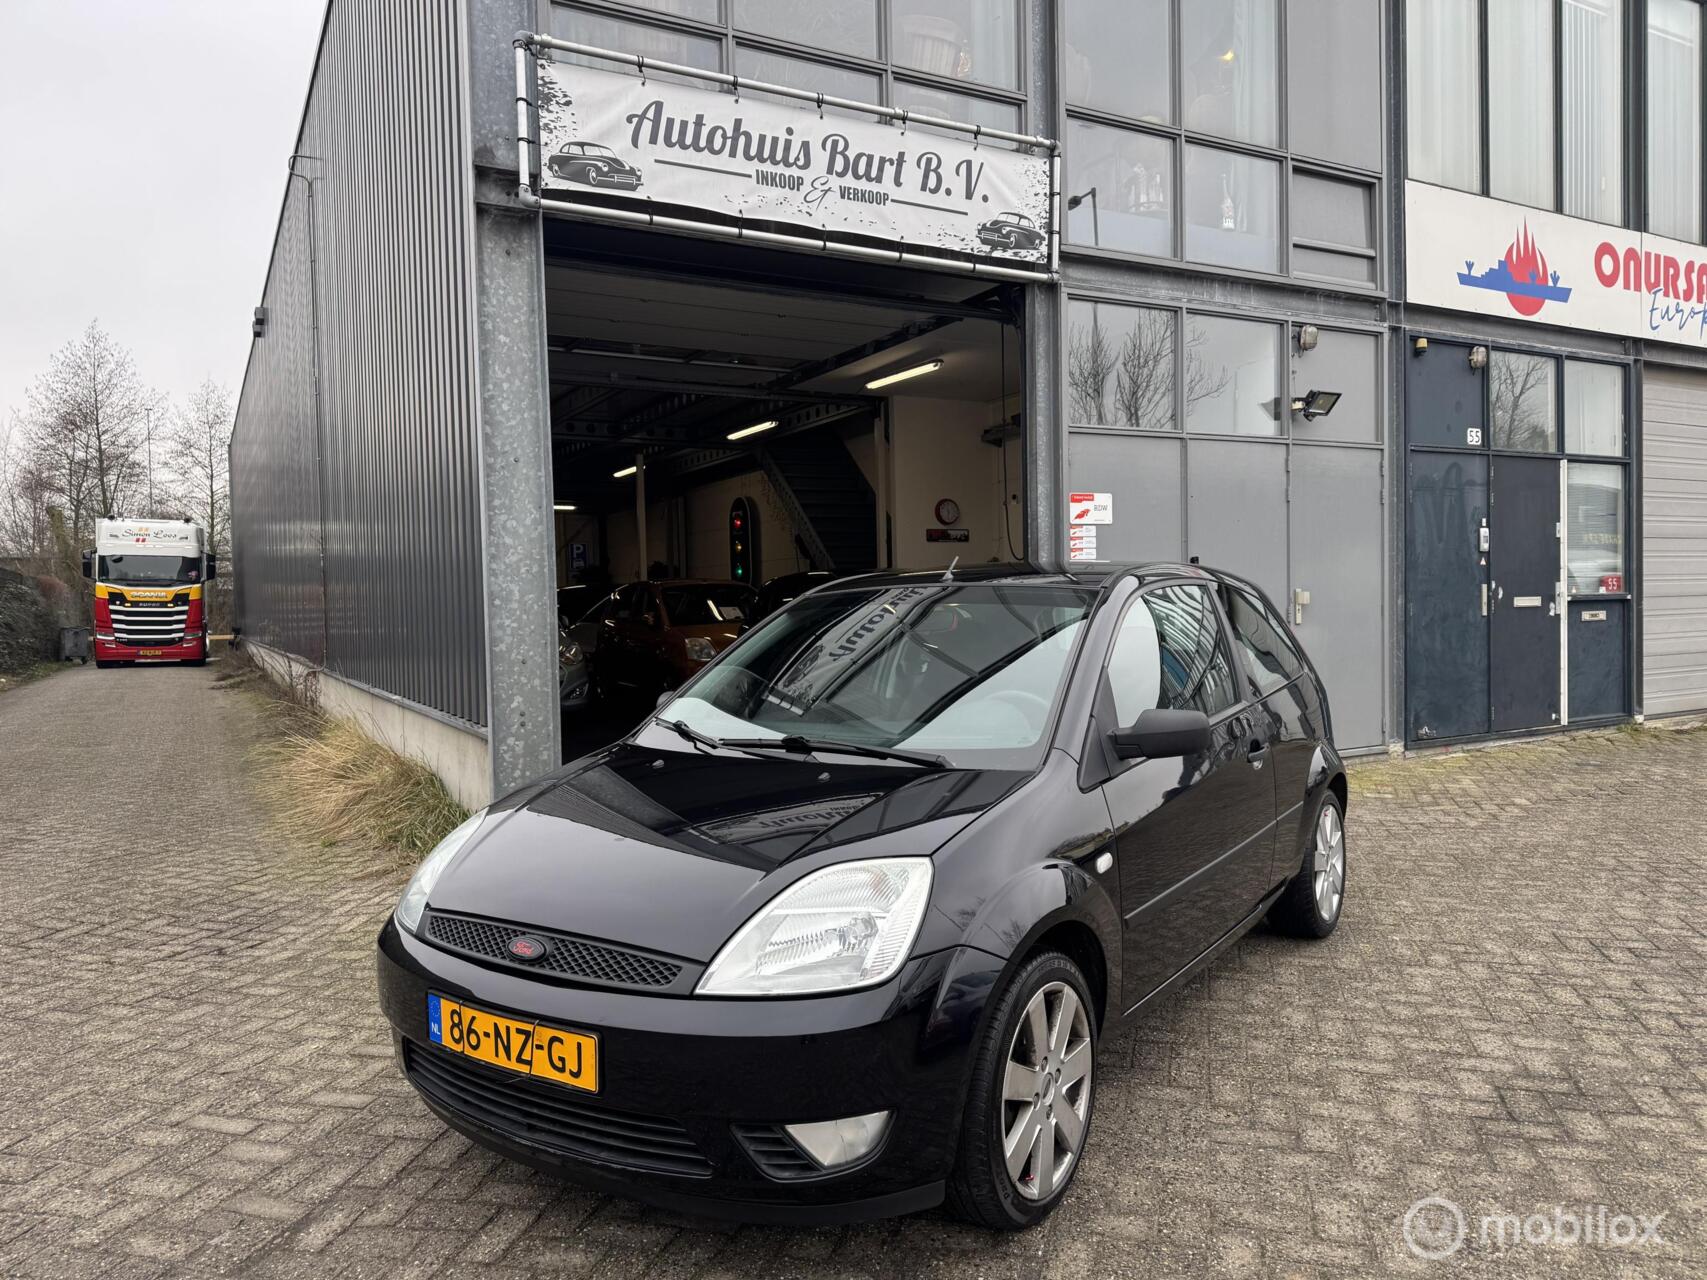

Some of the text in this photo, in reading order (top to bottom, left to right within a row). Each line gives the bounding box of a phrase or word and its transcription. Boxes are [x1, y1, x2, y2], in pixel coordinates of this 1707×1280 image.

[625, 100, 990, 204] Autohuis Bart B.V.
[755, 169, 804, 192] INKOOP
[838, 185, 890, 206] VERKOOP
[1468, 429, 1481, 444] 55
[122, 528, 151, 538] Simon
[572, 543, 584, 558] P
[1608, 577, 1618, 590] 55
[130, 591, 167, 599] SCANIA
[512, 941, 535, 956] Ford
[431, 1020, 441, 1035] NL
[449, 1008, 583, 1080] 86-NZ-GJ
